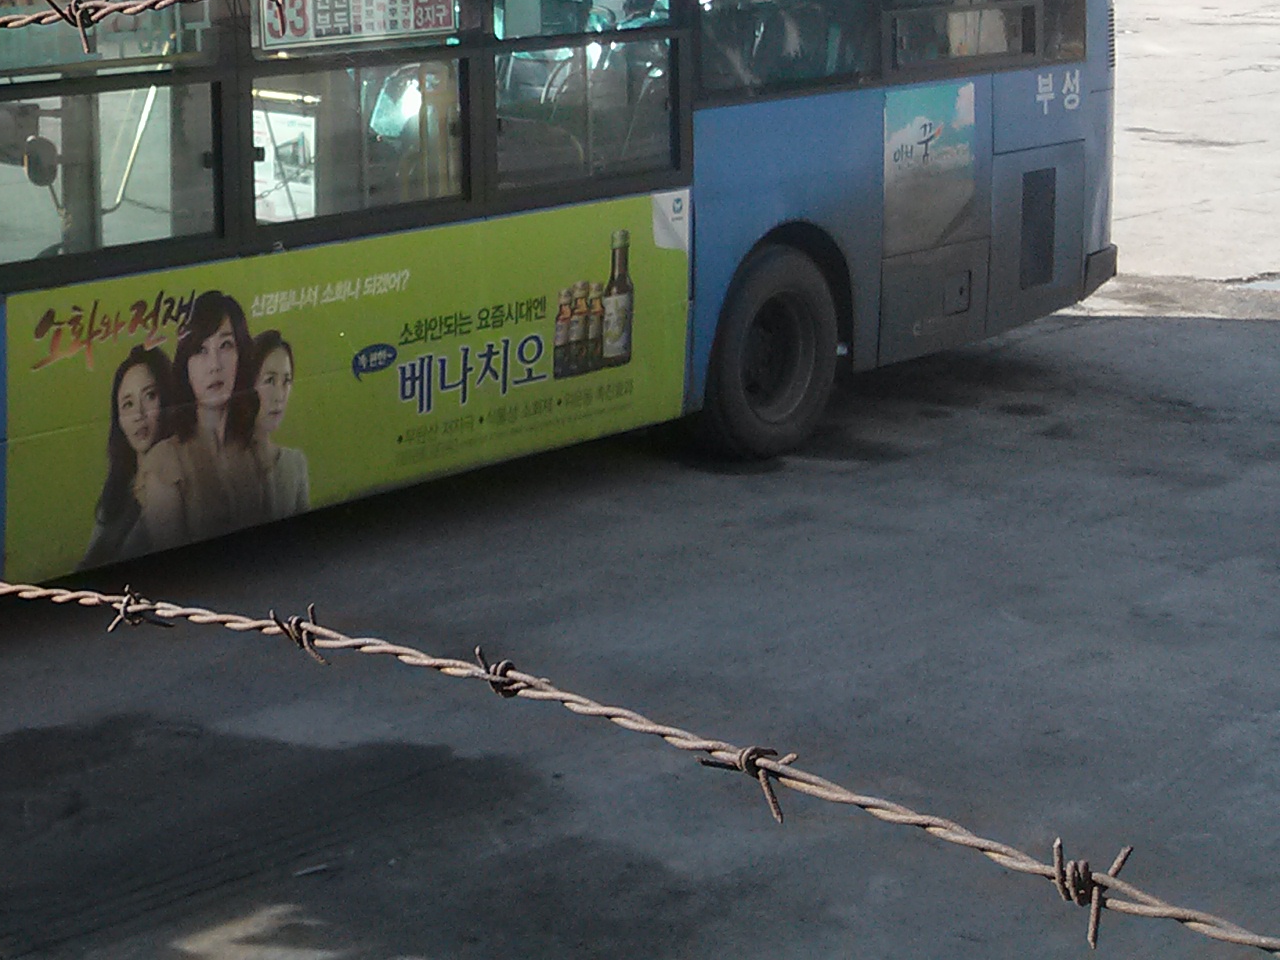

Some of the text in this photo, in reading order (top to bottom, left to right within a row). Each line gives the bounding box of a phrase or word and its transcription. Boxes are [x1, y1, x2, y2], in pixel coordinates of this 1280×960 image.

[1035, 69, 1081, 115] 부성
[398, 296, 547, 346] 소화안되는 요즘시대엔
[398, 334, 548, 414] 베나치오
